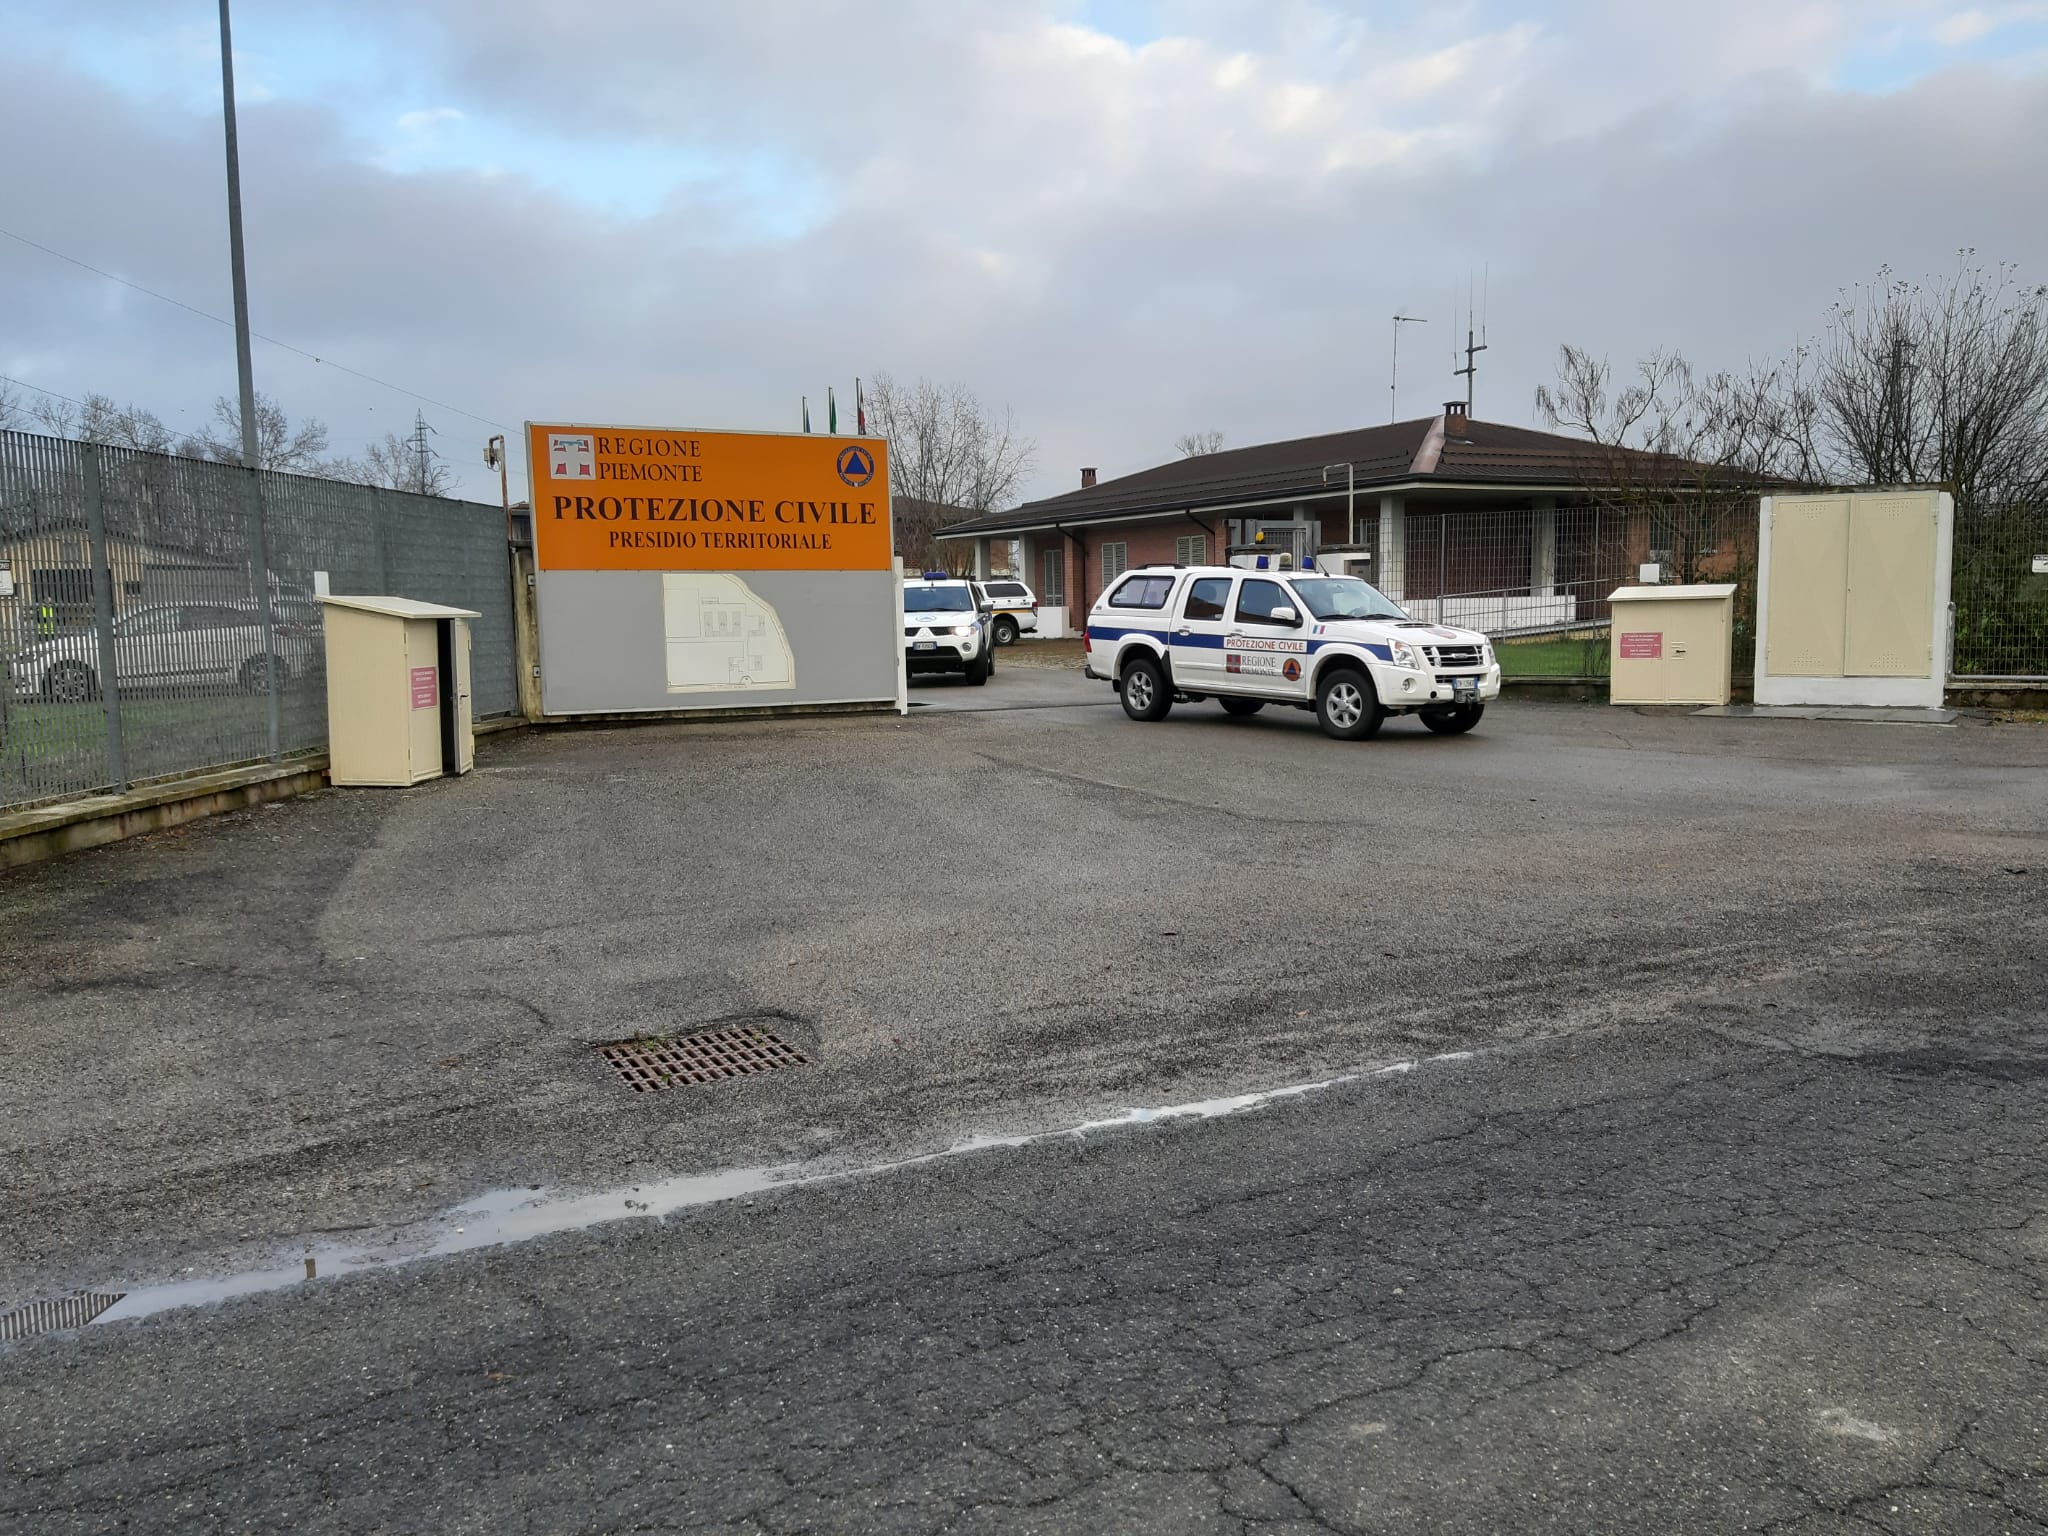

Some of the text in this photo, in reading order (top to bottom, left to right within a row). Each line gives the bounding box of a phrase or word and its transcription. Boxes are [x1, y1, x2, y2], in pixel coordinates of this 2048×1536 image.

[598, 437, 701, 457] REGIONE
[600, 463, 703, 482] PIEMONTE
[552, 496, 876, 524] PROTEZIONE CIVILE
[609, 531, 832, 549] PRESIDIO TERRITORIALE
[1226, 639, 1304, 651] PROTEZIONE CIVILE
[1241, 656, 1276, 667] REGIONE
